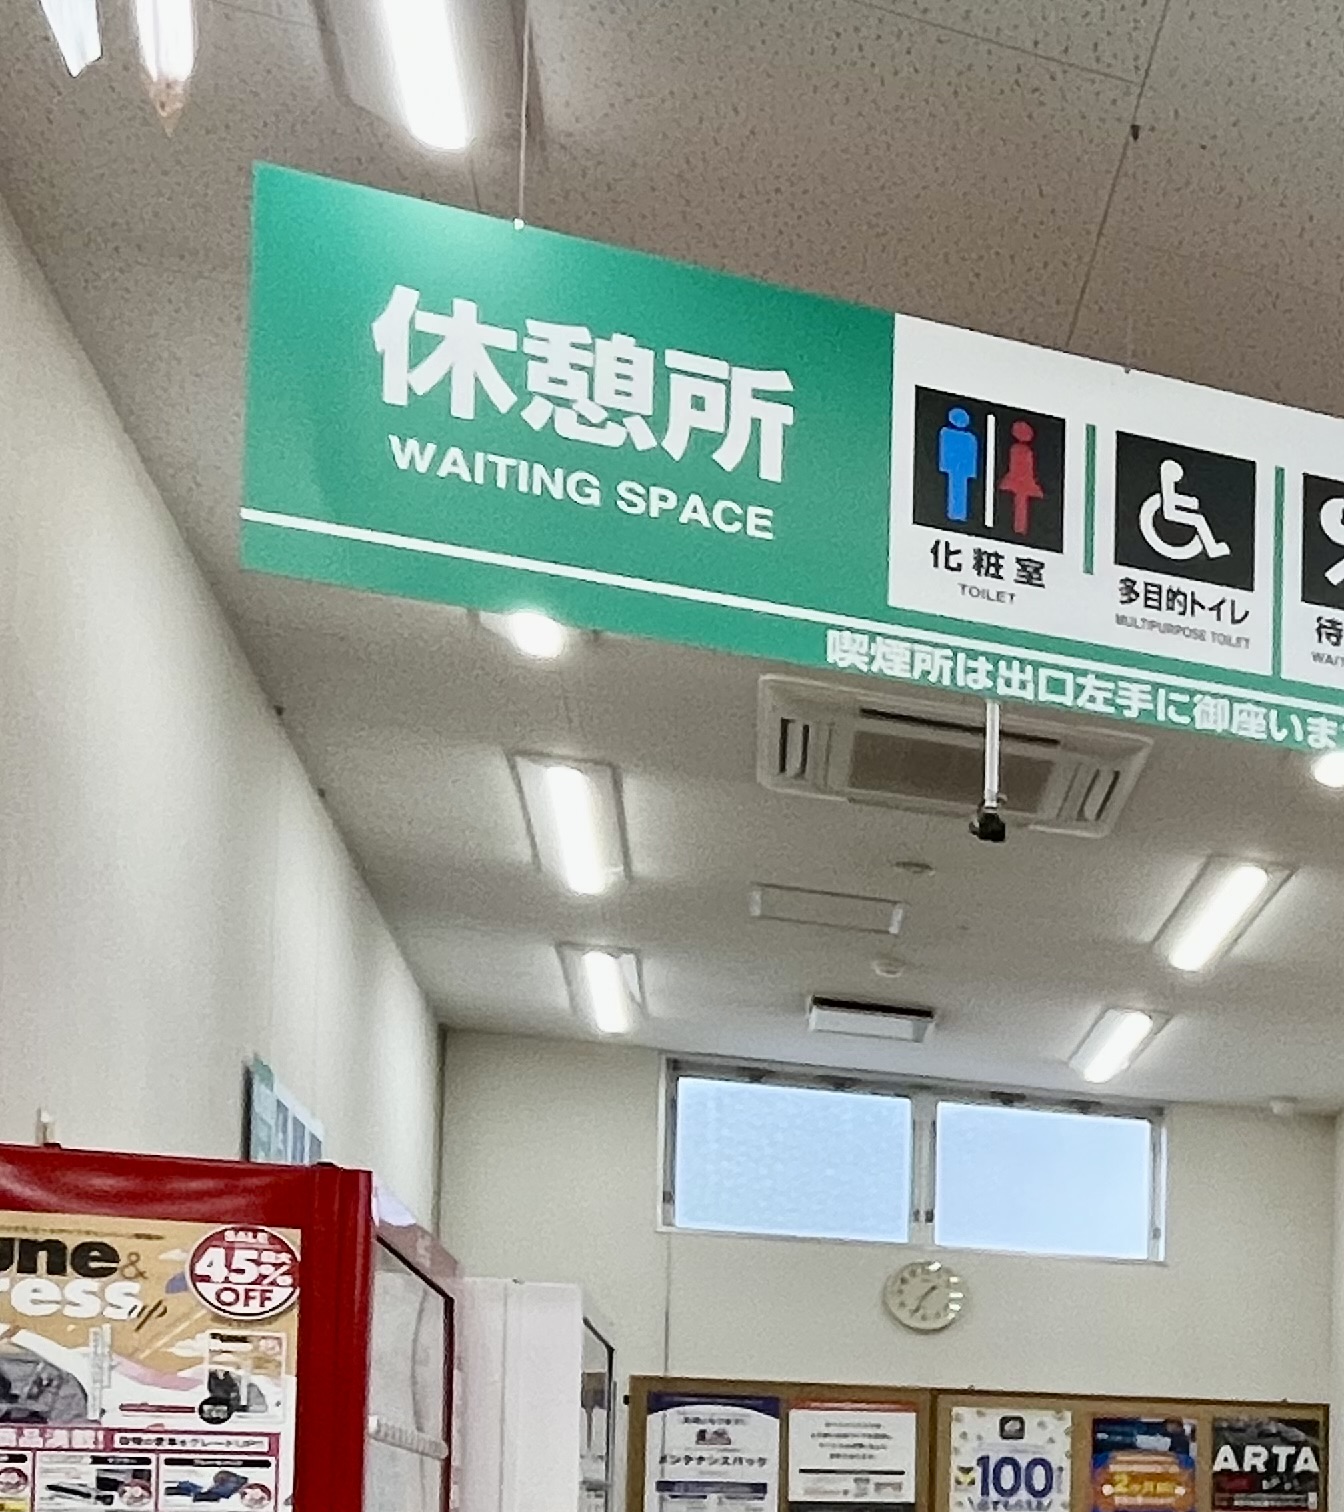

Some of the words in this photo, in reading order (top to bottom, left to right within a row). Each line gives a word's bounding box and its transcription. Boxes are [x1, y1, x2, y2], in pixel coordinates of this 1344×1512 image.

[371, 284, 794, 483] 休憩所
[389, 435, 600, 507] WAITING
[616, 480, 774, 540] SPACE
[930, 540, 1046, 589] 化粧室
[958, 583, 1016, 605] TOILET
[1118, 577, 1250, 625] 多目的トイレ
[224, 1230, 269, 1243] SALE
[120, 1252, 147, 1280] &
[195, 1246, 293, 1287] 45%
[214, 1286, 274, 1308] OFF
[976, 1455, 1054, 1498] 100
[1212, 1443, 1321, 1473] ARTA
